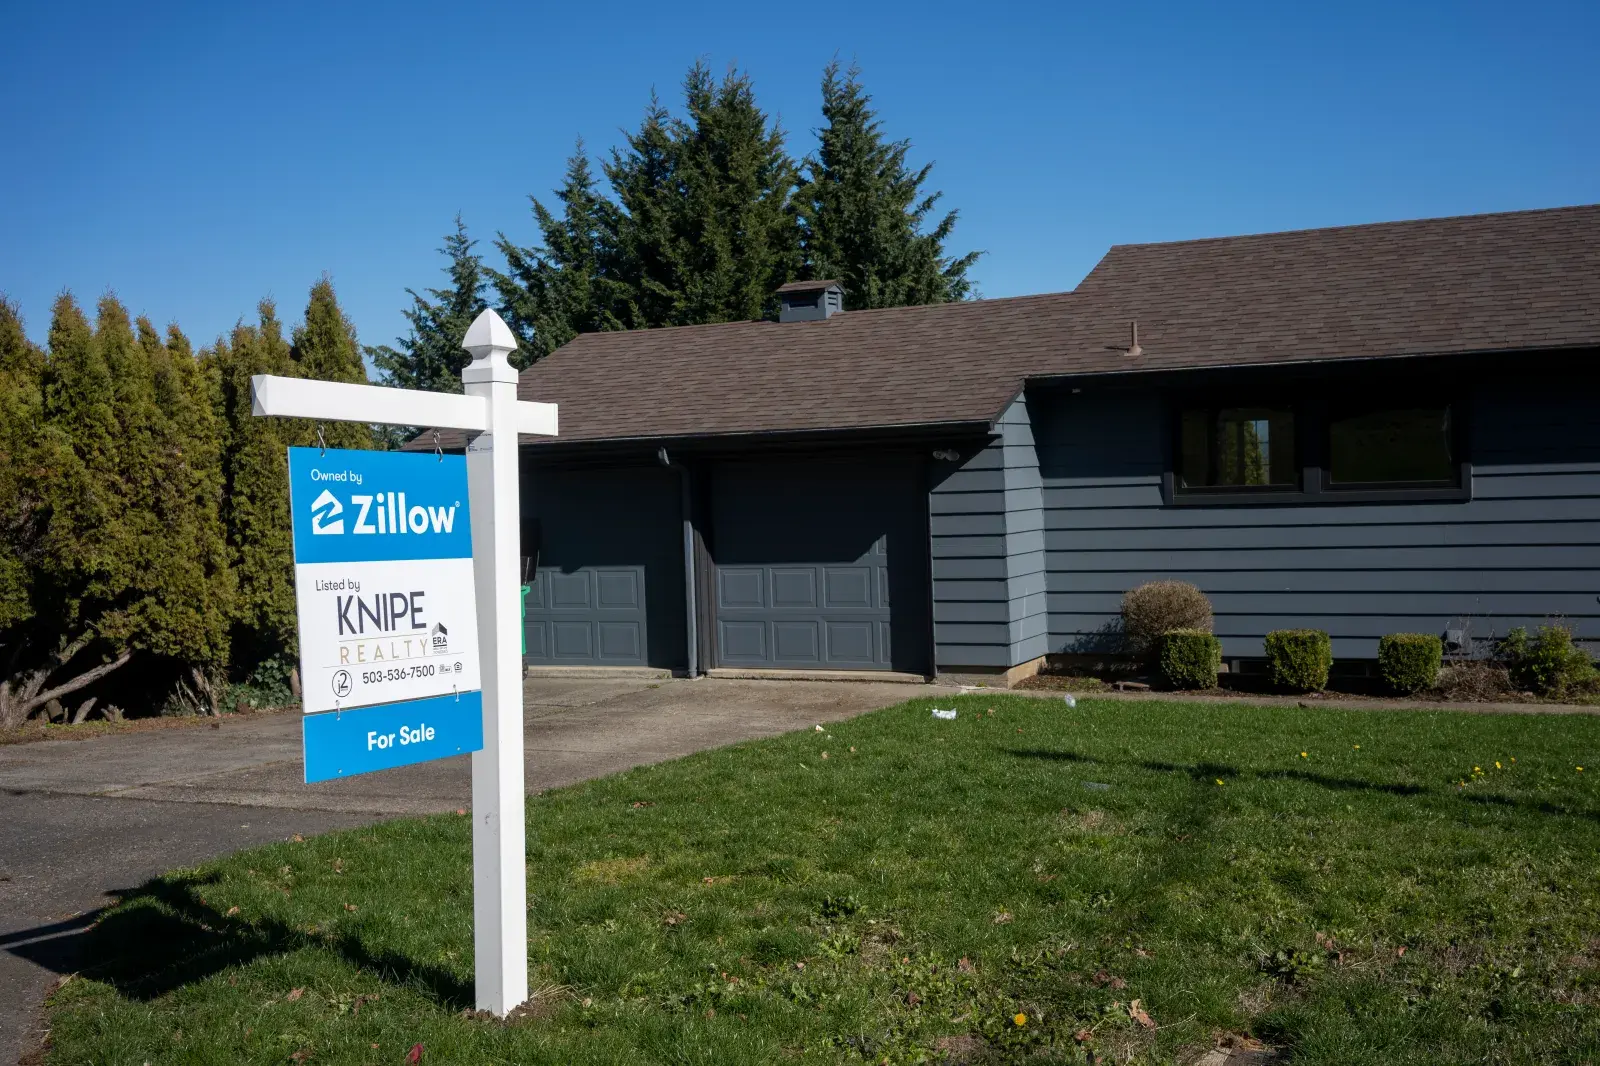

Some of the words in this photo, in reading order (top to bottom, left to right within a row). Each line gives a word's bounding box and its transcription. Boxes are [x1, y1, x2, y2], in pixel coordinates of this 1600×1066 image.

[311, 469, 347, 482] Owned
[349, 470, 363, 485] by
[351, 491, 456, 535] Zillow
[315, 579, 345, 591] Listed
[347, 578, 361, 592] by
[336, 591, 427, 635] KNIPE
[340, 638, 428, 664] REALTY
[432, 636, 447, 645] ERA
[362, 664, 435, 684] 503-536-7500
[367, 731, 395, 751] For
[399, 723, 435, 745] Sale
